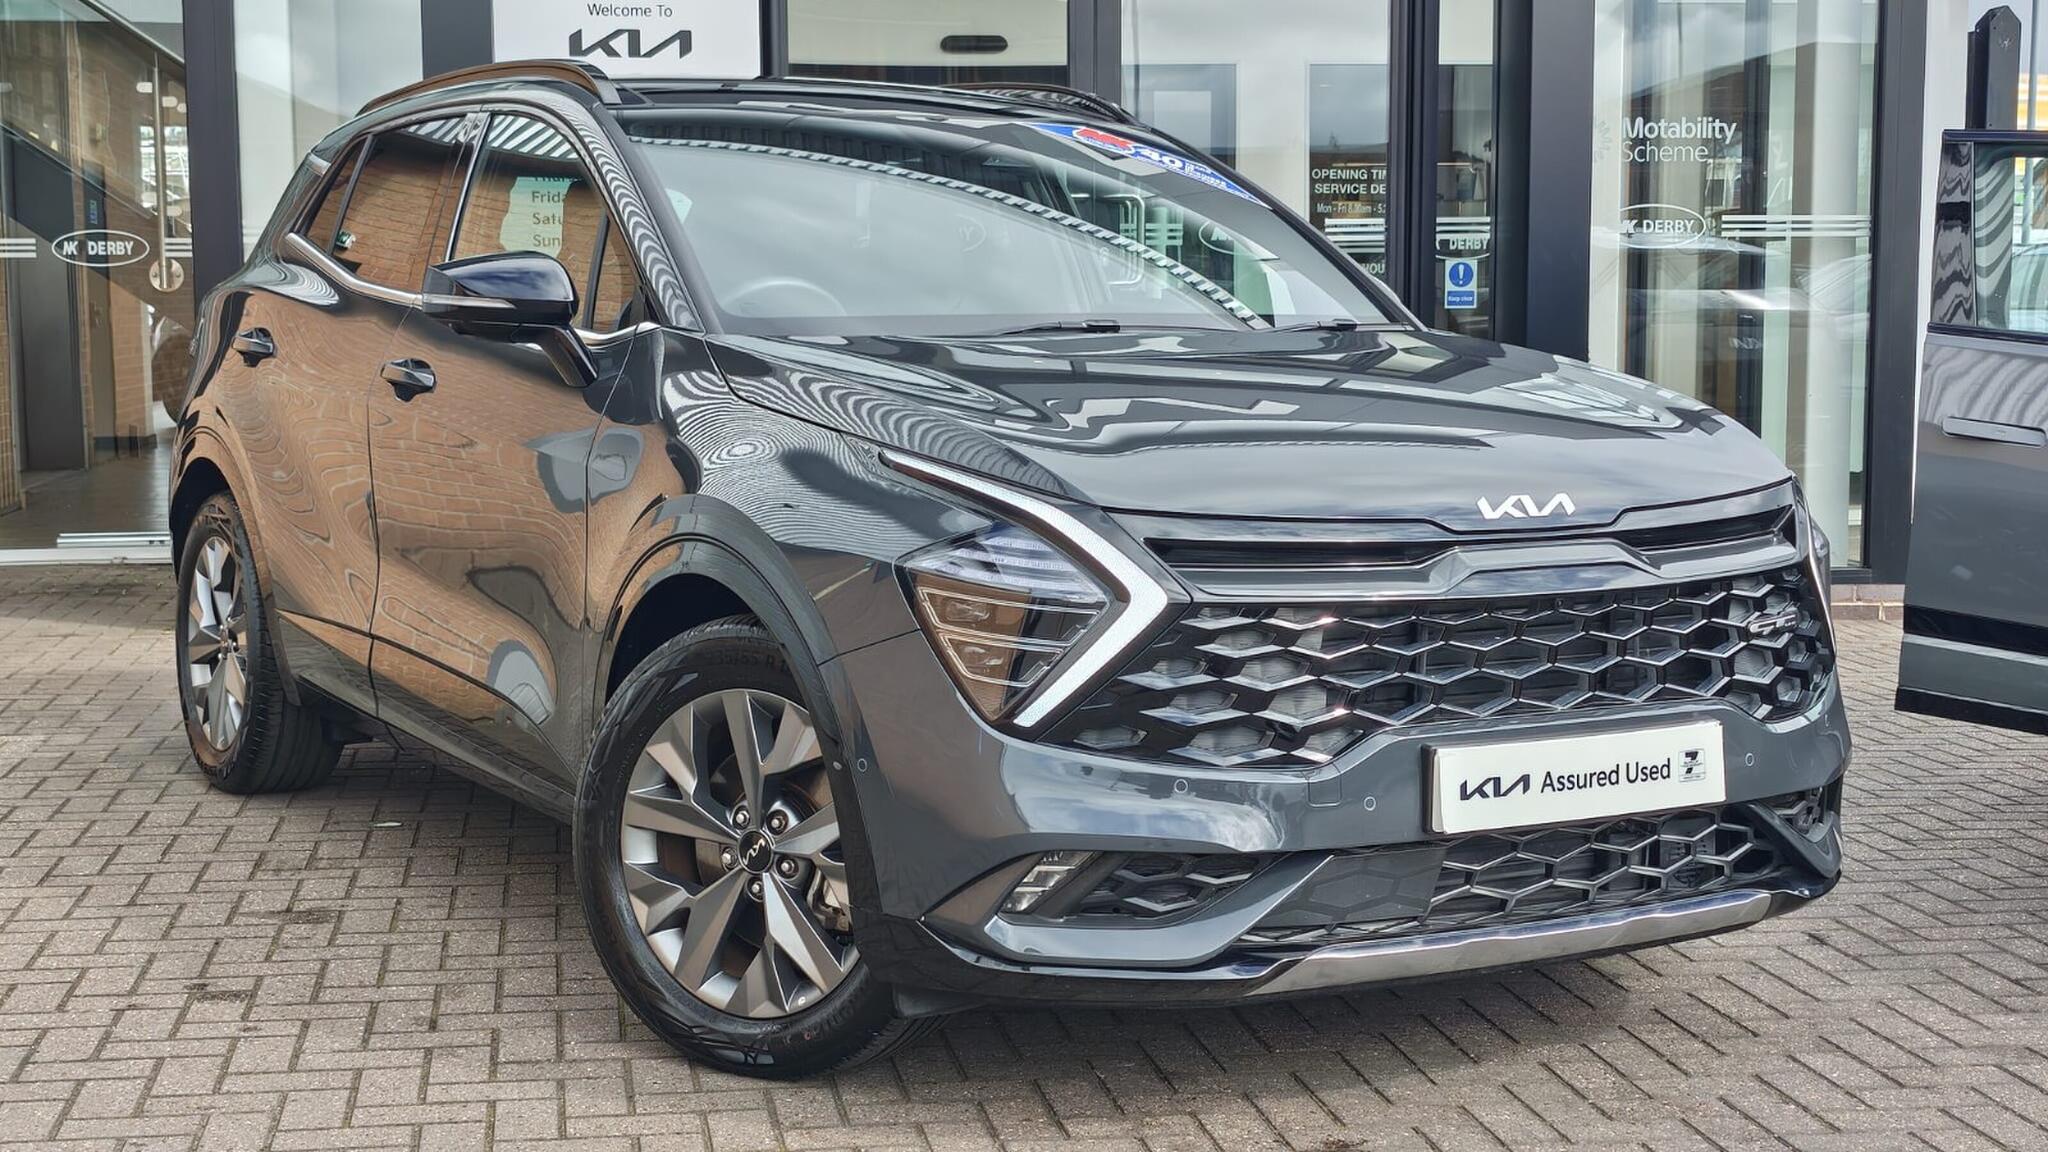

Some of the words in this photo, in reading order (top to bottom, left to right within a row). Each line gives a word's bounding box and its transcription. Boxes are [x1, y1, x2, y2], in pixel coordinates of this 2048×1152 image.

[587, 4, 652, 17] Welcome
[656, 5, 673, 18] To
[569, 28, 692, 59] KIA
[1622, 116, 1737, 145] Motability
[1622, 141, 1709, 162] Scheme
[1312, 168, 1368, 180] OPENING
[1314, 183, 1368, 194] SERVICE
[1316, 203, 1332, 213] Mon
[1643, 219, 1695, 234] DERBY
[87, 240, 134, 255] DERBY
[1450, 237, 1489, 250] DERBY
[1477, 493, 1576, 519] KIA
[1459, 774, 1530, 801] KIA
[1540, 763, 1620, 794] Assured
[1625, 757, 1671, 784] Used
